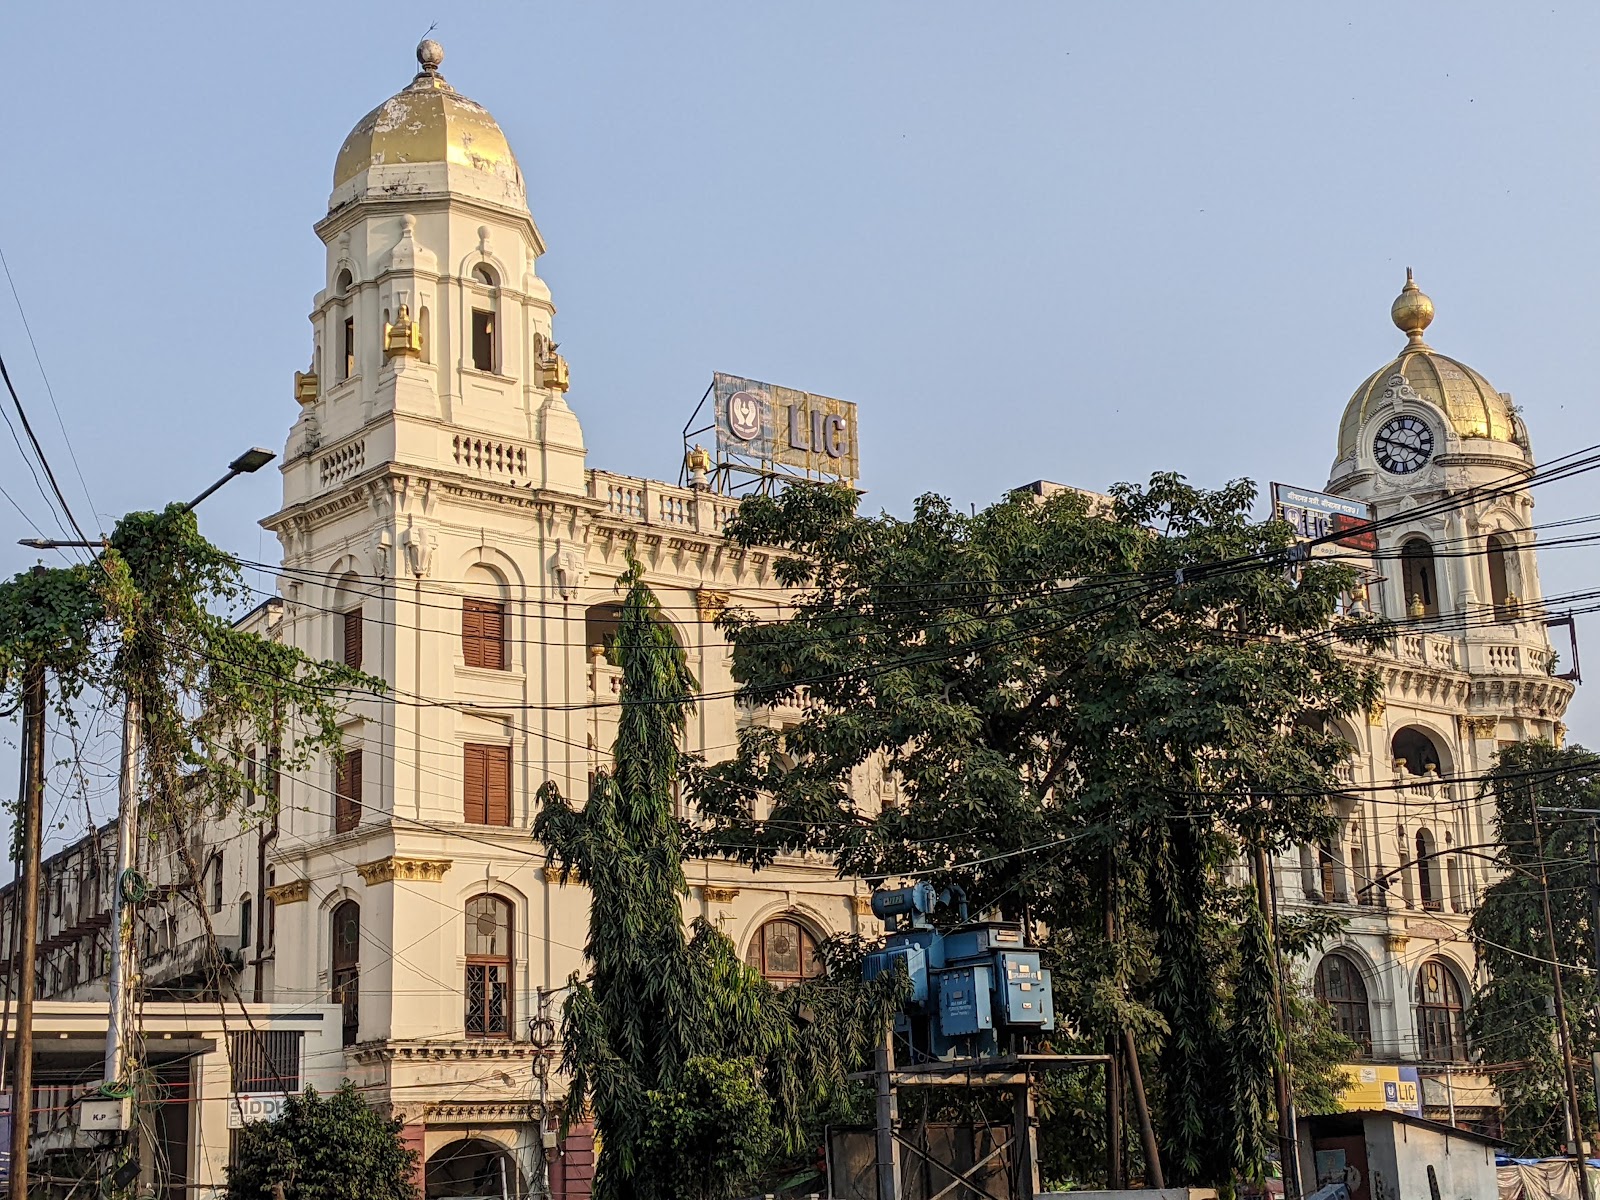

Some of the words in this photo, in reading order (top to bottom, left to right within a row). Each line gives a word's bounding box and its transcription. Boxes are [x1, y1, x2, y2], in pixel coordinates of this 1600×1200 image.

[788, 405, 846, 458] LIC
[1305, 509, 1330, 539] LIC
[1398, 1084, 1415, 1101] LIC
[231, 1100, 284, 1115] SIDDH
